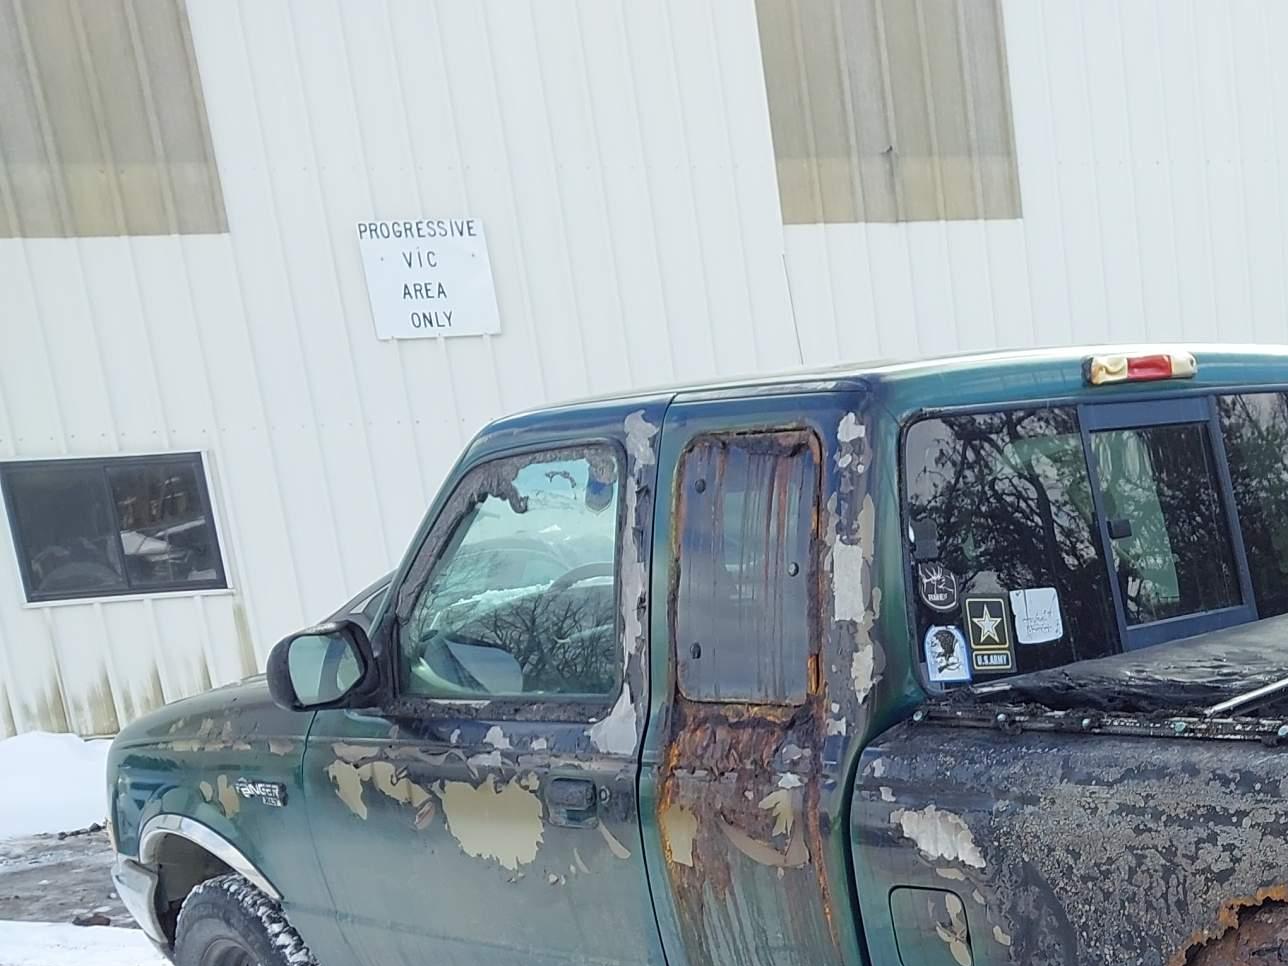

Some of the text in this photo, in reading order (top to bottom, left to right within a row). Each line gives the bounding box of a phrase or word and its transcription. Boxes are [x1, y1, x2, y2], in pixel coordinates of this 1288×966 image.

[357, 219, 477, 240] PROGRESSIVE
[402, 250, 438, 269] VIC
[402, 281, 448, 300] AREA
[410, 311, 453, 329] ONLY
